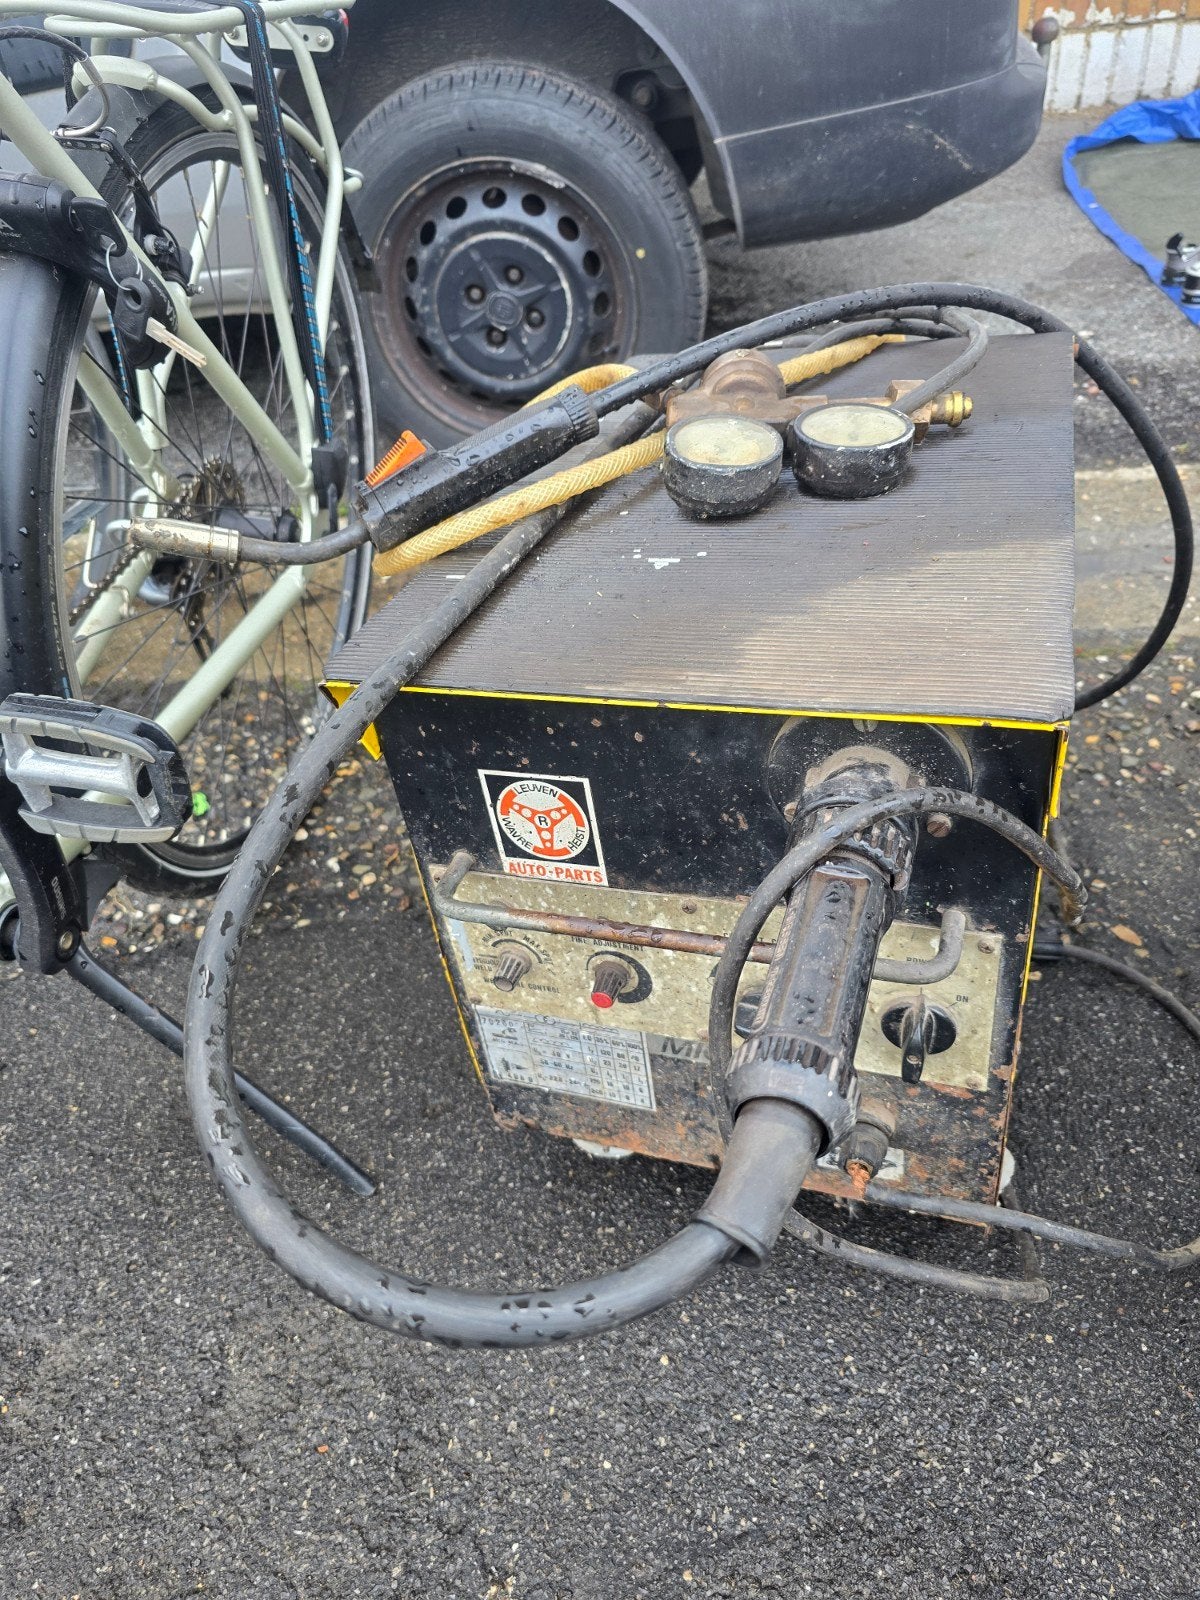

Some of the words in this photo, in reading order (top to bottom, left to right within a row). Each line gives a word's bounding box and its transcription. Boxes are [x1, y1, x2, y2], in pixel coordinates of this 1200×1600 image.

[514, 783, 558, 797] LEUVEN
[538, 815, 549, 826] R
[502, 816, 533, 850] WAVRE
[567, 827, 585, 851] HEIST
[508, 861, 603, 883] AUTO-PARTS
[956, 994, 969, 1003] ON
